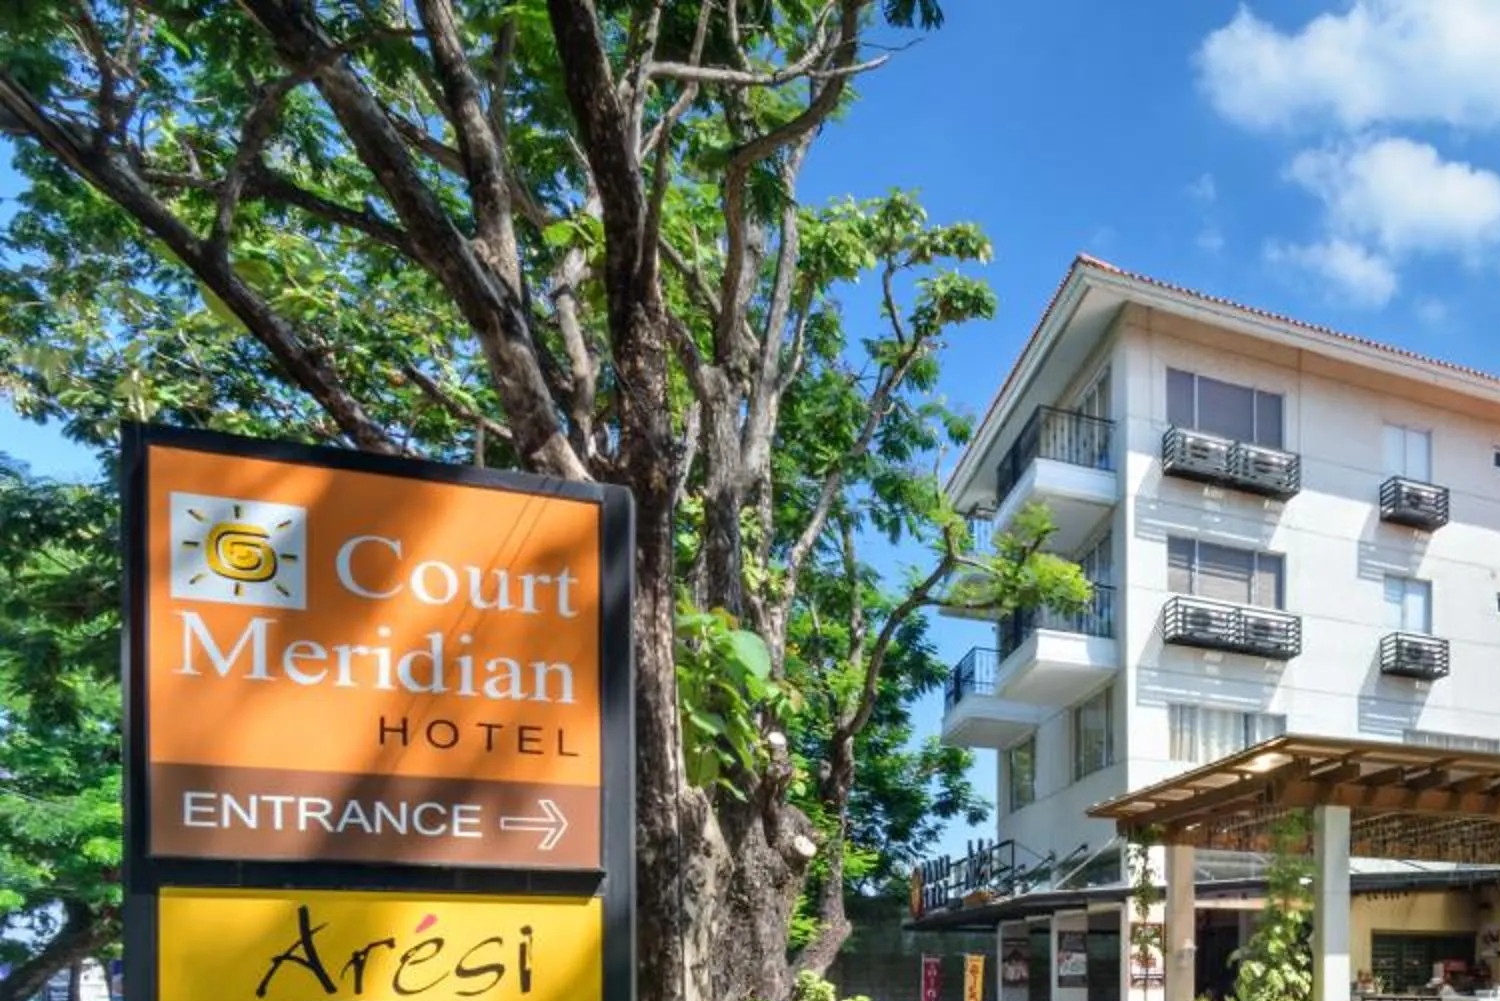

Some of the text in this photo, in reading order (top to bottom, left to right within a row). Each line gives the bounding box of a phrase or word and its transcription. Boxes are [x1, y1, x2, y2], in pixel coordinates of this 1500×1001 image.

[335, 535, 579, 618] Court
[172, 610, 575, 704] Meridian
[377, 715, 579, 757] HOTEL
[182, 791, 484, 838] ENTRANCE
[255, 905, 533, 997] Arési
